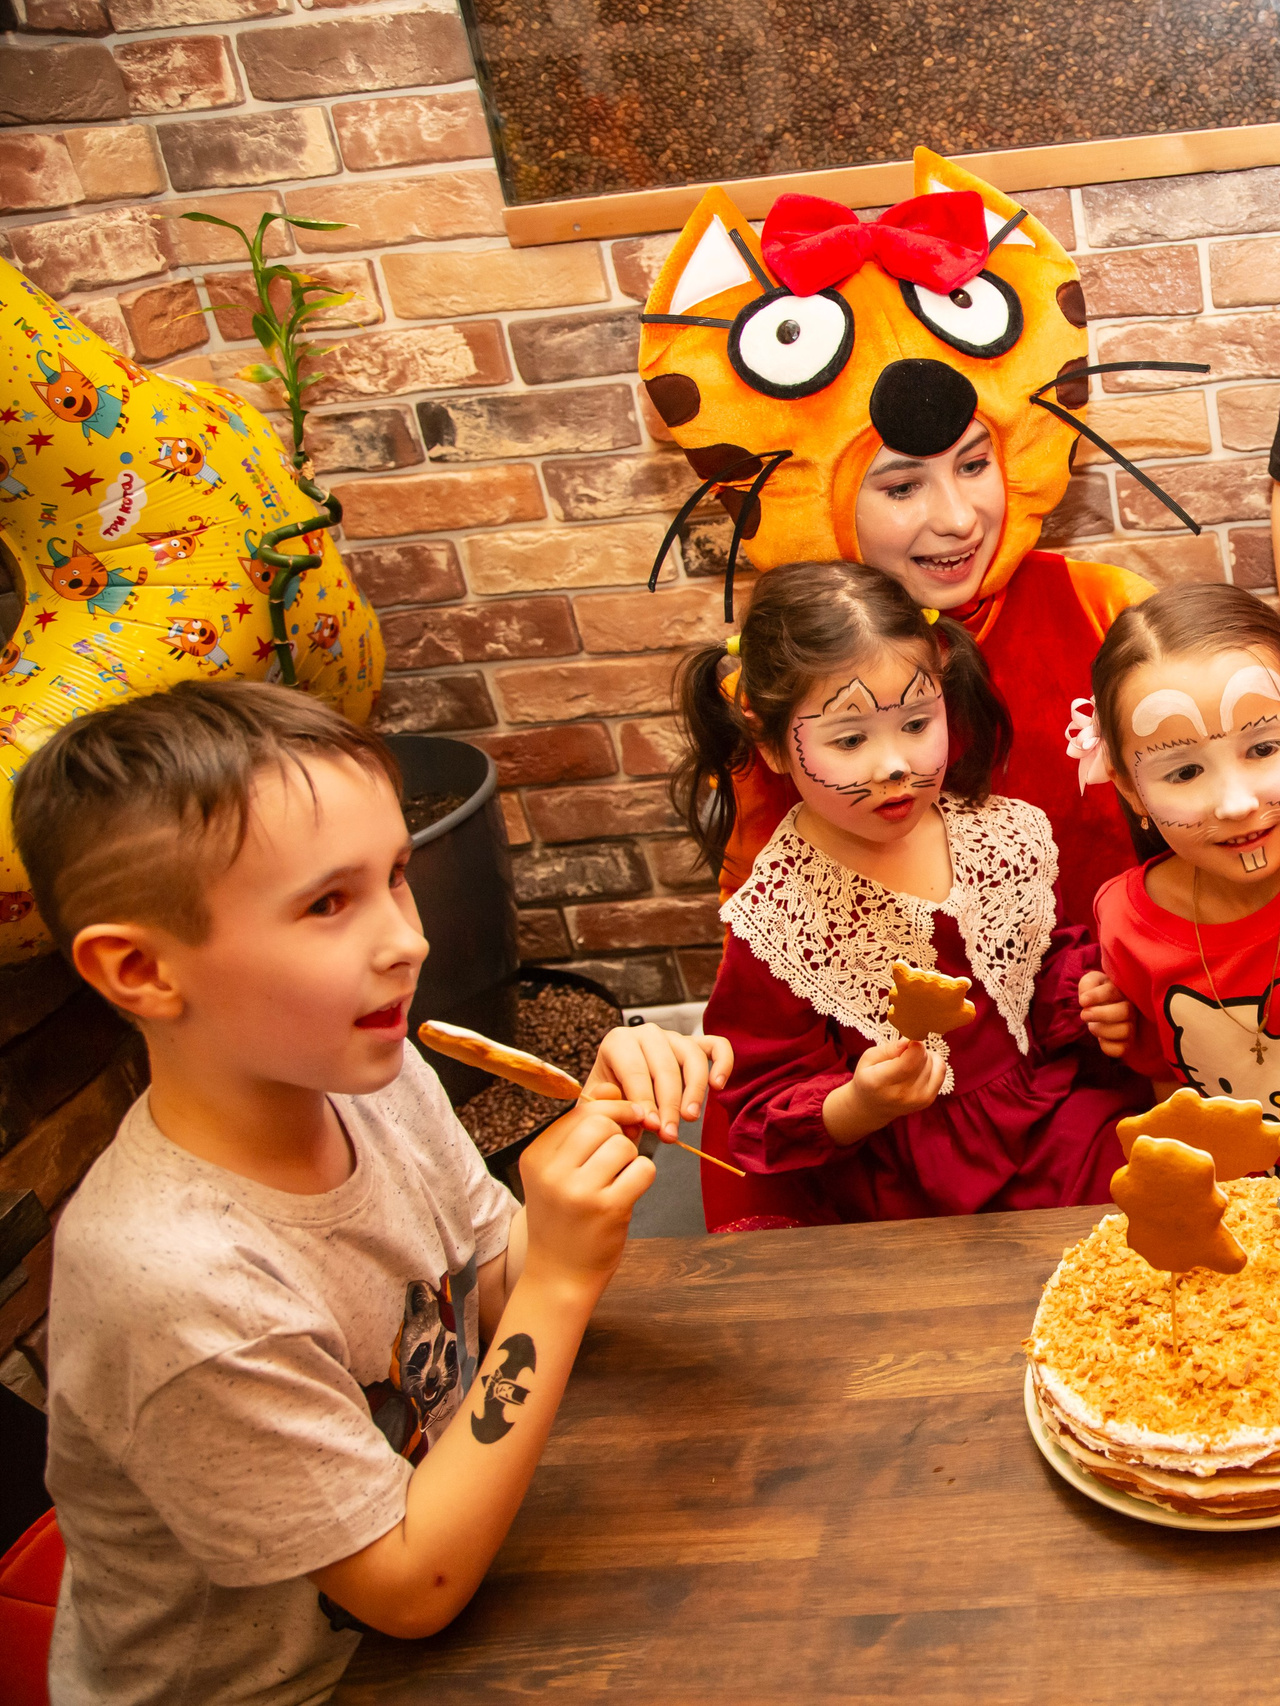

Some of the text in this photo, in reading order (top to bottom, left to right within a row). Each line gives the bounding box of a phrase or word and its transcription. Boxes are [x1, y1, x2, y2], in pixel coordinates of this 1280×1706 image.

[13, 316, 43, 347] УРА!
[37, 502, 58, 529] УРА!
[229, 493, 252, 520] УРА!
[49, 675, 81, 699] УРА!
